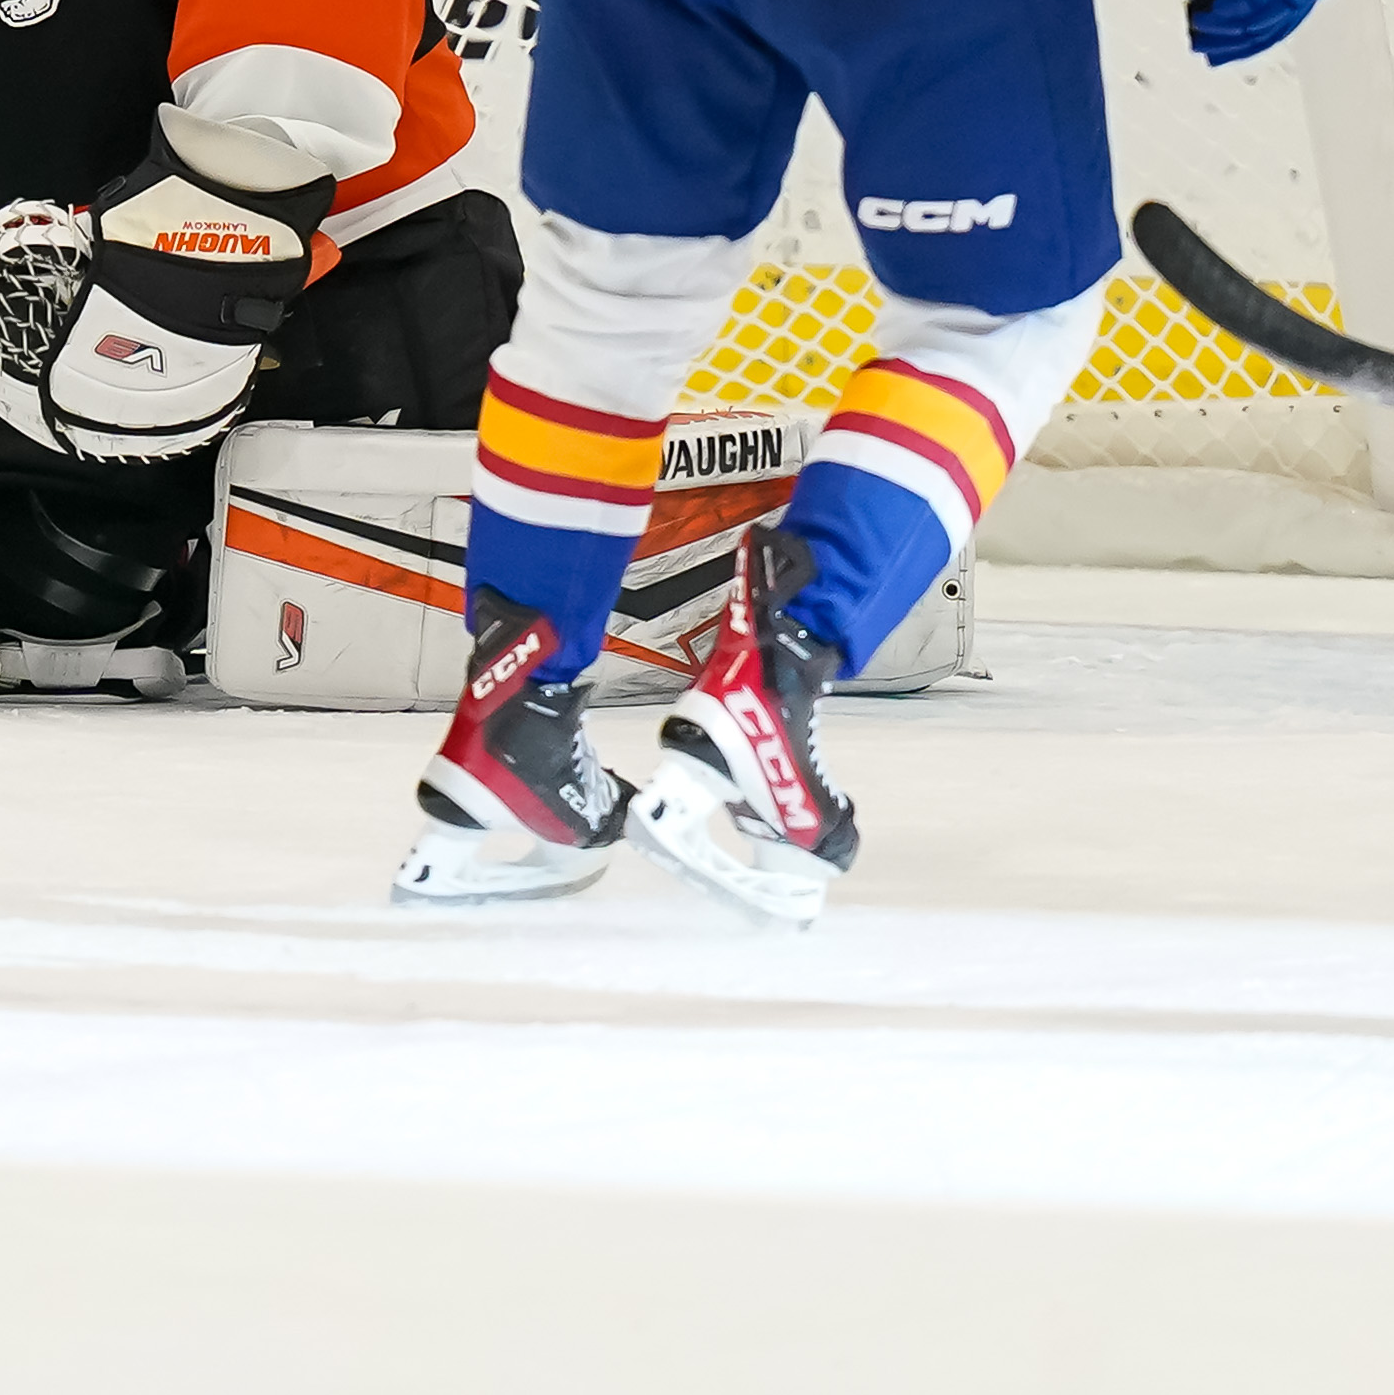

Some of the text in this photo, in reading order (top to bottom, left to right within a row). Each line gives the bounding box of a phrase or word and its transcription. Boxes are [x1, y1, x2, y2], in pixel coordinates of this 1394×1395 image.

[856, 193, 1018, 234] CCM
[153, 231, 272, 256] VAUGHN
[471, 631, 542, 700] CCM
[722, 683, 820, 831] CCM
